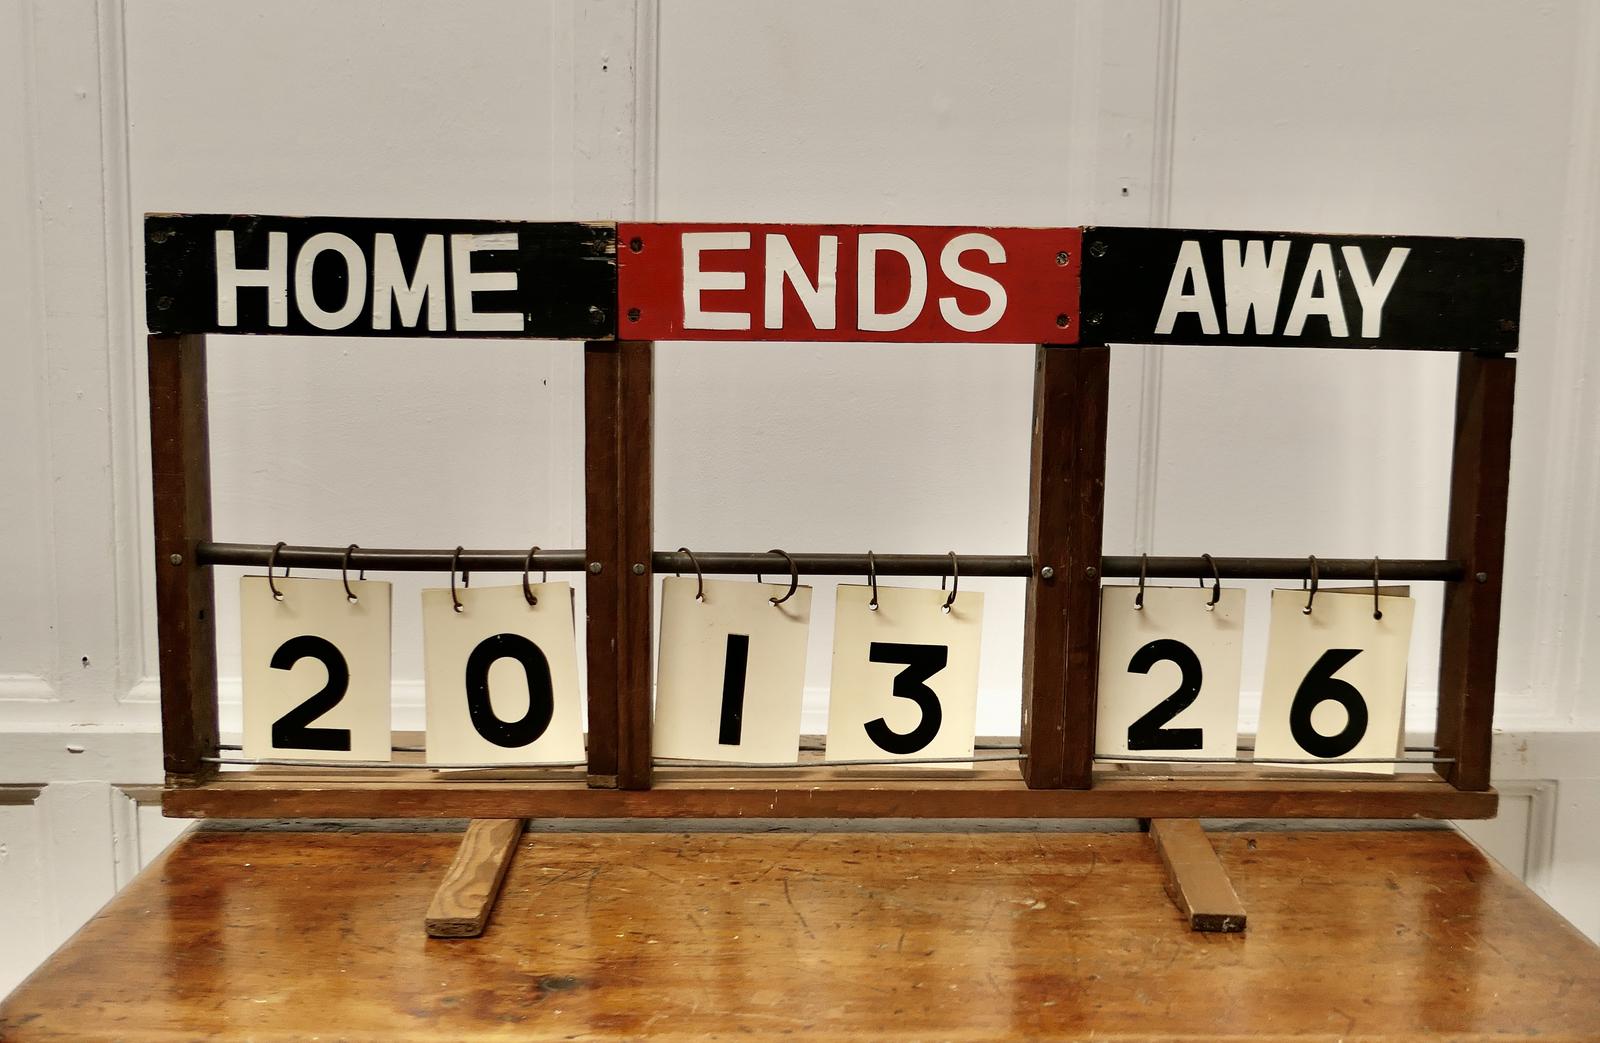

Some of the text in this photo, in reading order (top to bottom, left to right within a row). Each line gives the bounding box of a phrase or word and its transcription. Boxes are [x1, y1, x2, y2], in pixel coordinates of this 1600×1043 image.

[215, 230, 526, 332] HOME
[681, 231, 1008, 333] ENDS
[1154, 239, 1411, 339] AWAY
